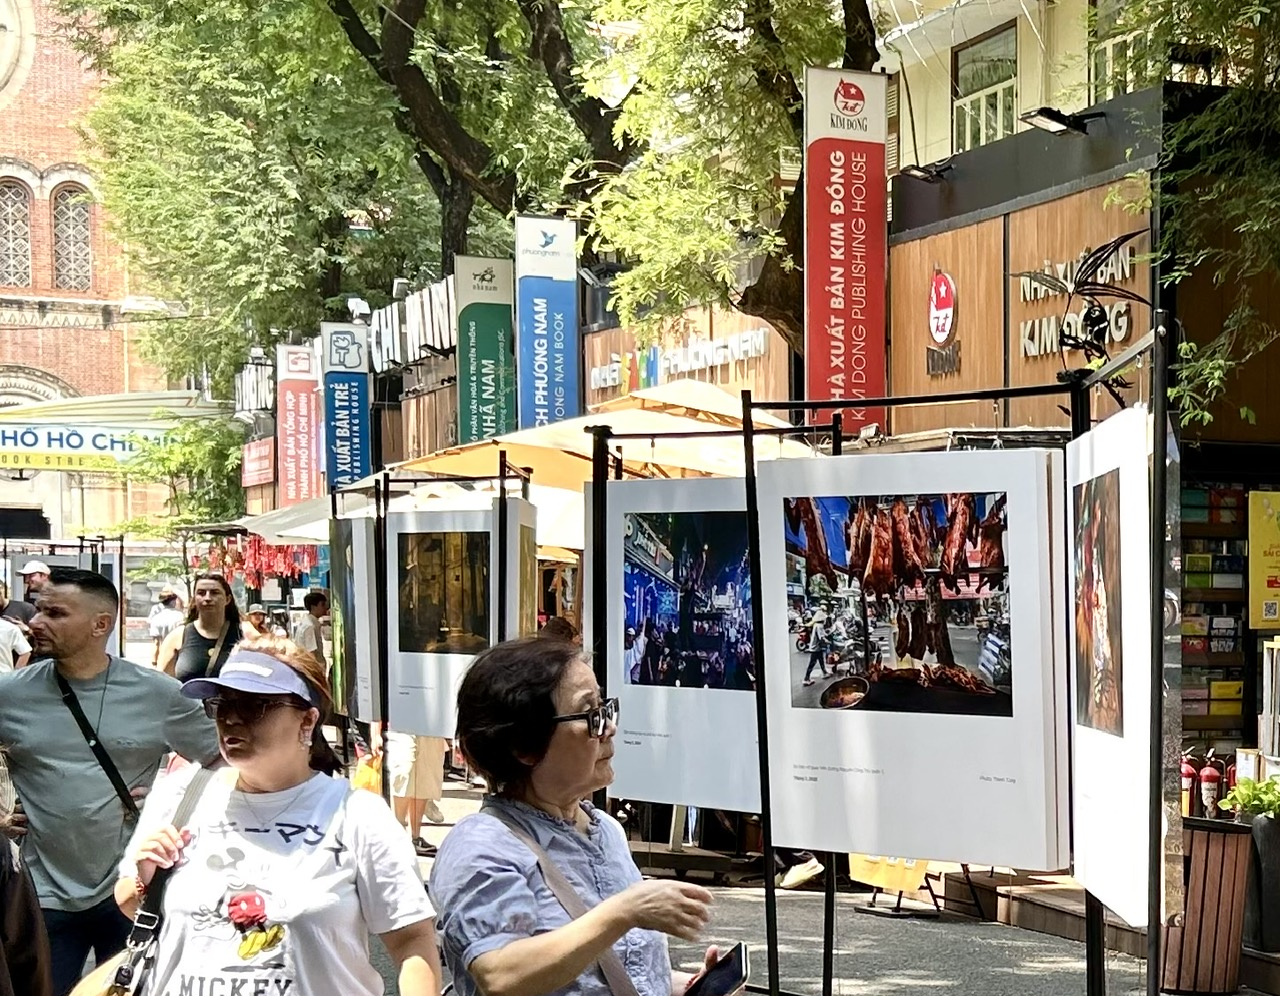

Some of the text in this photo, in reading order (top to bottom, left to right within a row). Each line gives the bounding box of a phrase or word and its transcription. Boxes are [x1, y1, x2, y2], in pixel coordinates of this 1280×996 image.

[830, 112, 845, 129] KIM
[830, 223, 845, 260] KIM
[825, 266, 845, 310] BẢN
[852, 152, 867, 420] KM DONG PUBLISHING HOUSE
[534, 298, 548, 334] NAM
[553, 312, 565, 351] BOOK
[824, 315, 845, 369] XUẤT
[1020, 315, 1058, 357] KIM
[533, 335, 549, 403] PHƯƠNG
[553, 357, 565, 383] NAM
[330, 382, 349, 407] TRẺ
[479, 359, 497, 439] NHÃ NAM
[330, 408, 350, 437] BẢN
[351, 382, 362, 480] PUBLISHING HOUSE
[330, 439, 351, 472] XUẤT
